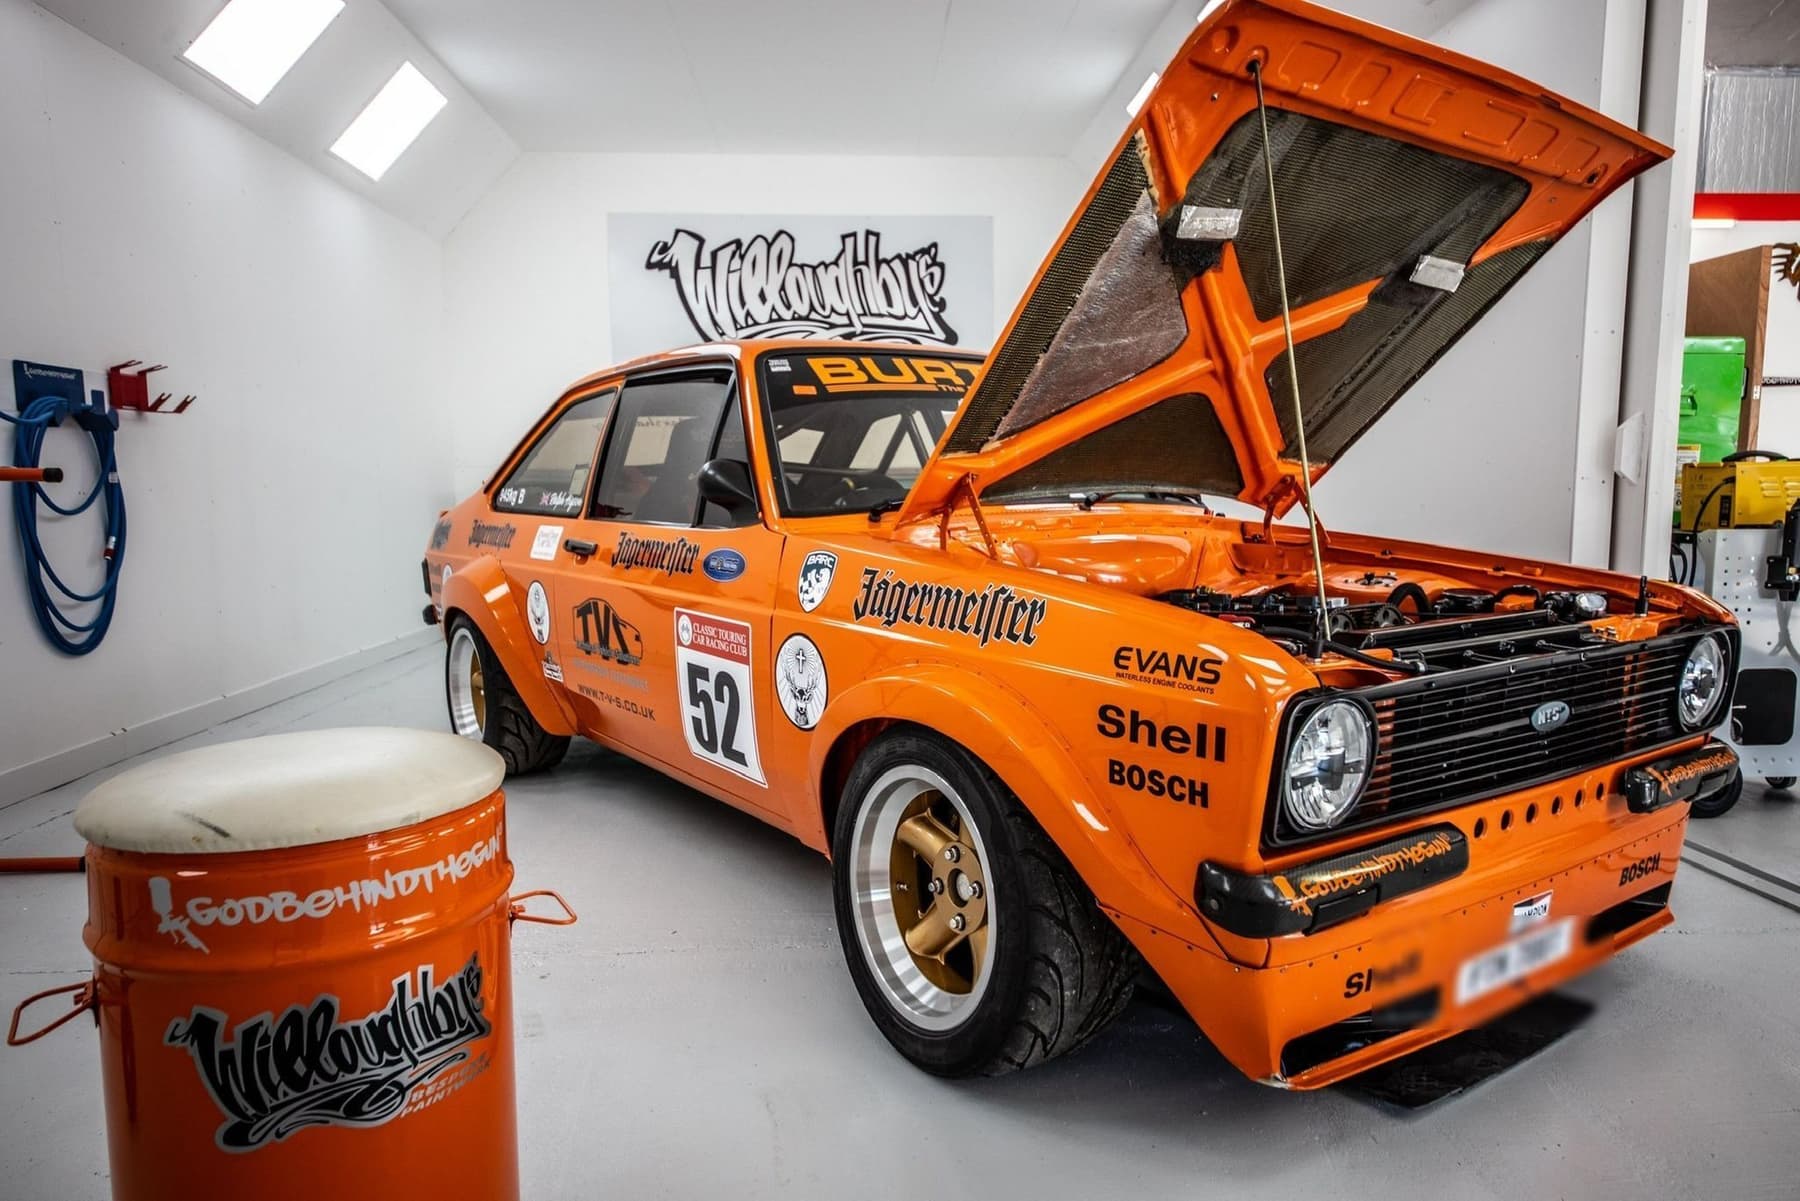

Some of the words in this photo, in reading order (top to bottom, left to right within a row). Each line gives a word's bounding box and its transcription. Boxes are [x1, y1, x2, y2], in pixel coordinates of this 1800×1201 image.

[806, 555, 834, 569] BARC
[693, 623, 717, 638] CLASSIC
[719, 629, 746, 645] TOURING
[693, 633, 705, 646] CAR
[706, 637, 729, 652] RACING
[730, 643, 748, 657] CLUB
[1113, 646, 1224, 685] EVANS
[1116, 672, 1151, 684] WATERLESS
[1152, 678, 1176, 689] ENGINE
[1177, 683, 1215, 695] COOLANTS
[687, 662, 748, 768] 52
[1097, 704, 1227, 762] Shell
[1108, 759, 1209, 808] BOSCH
[1619, 853, 1662, 886] BOSCH
